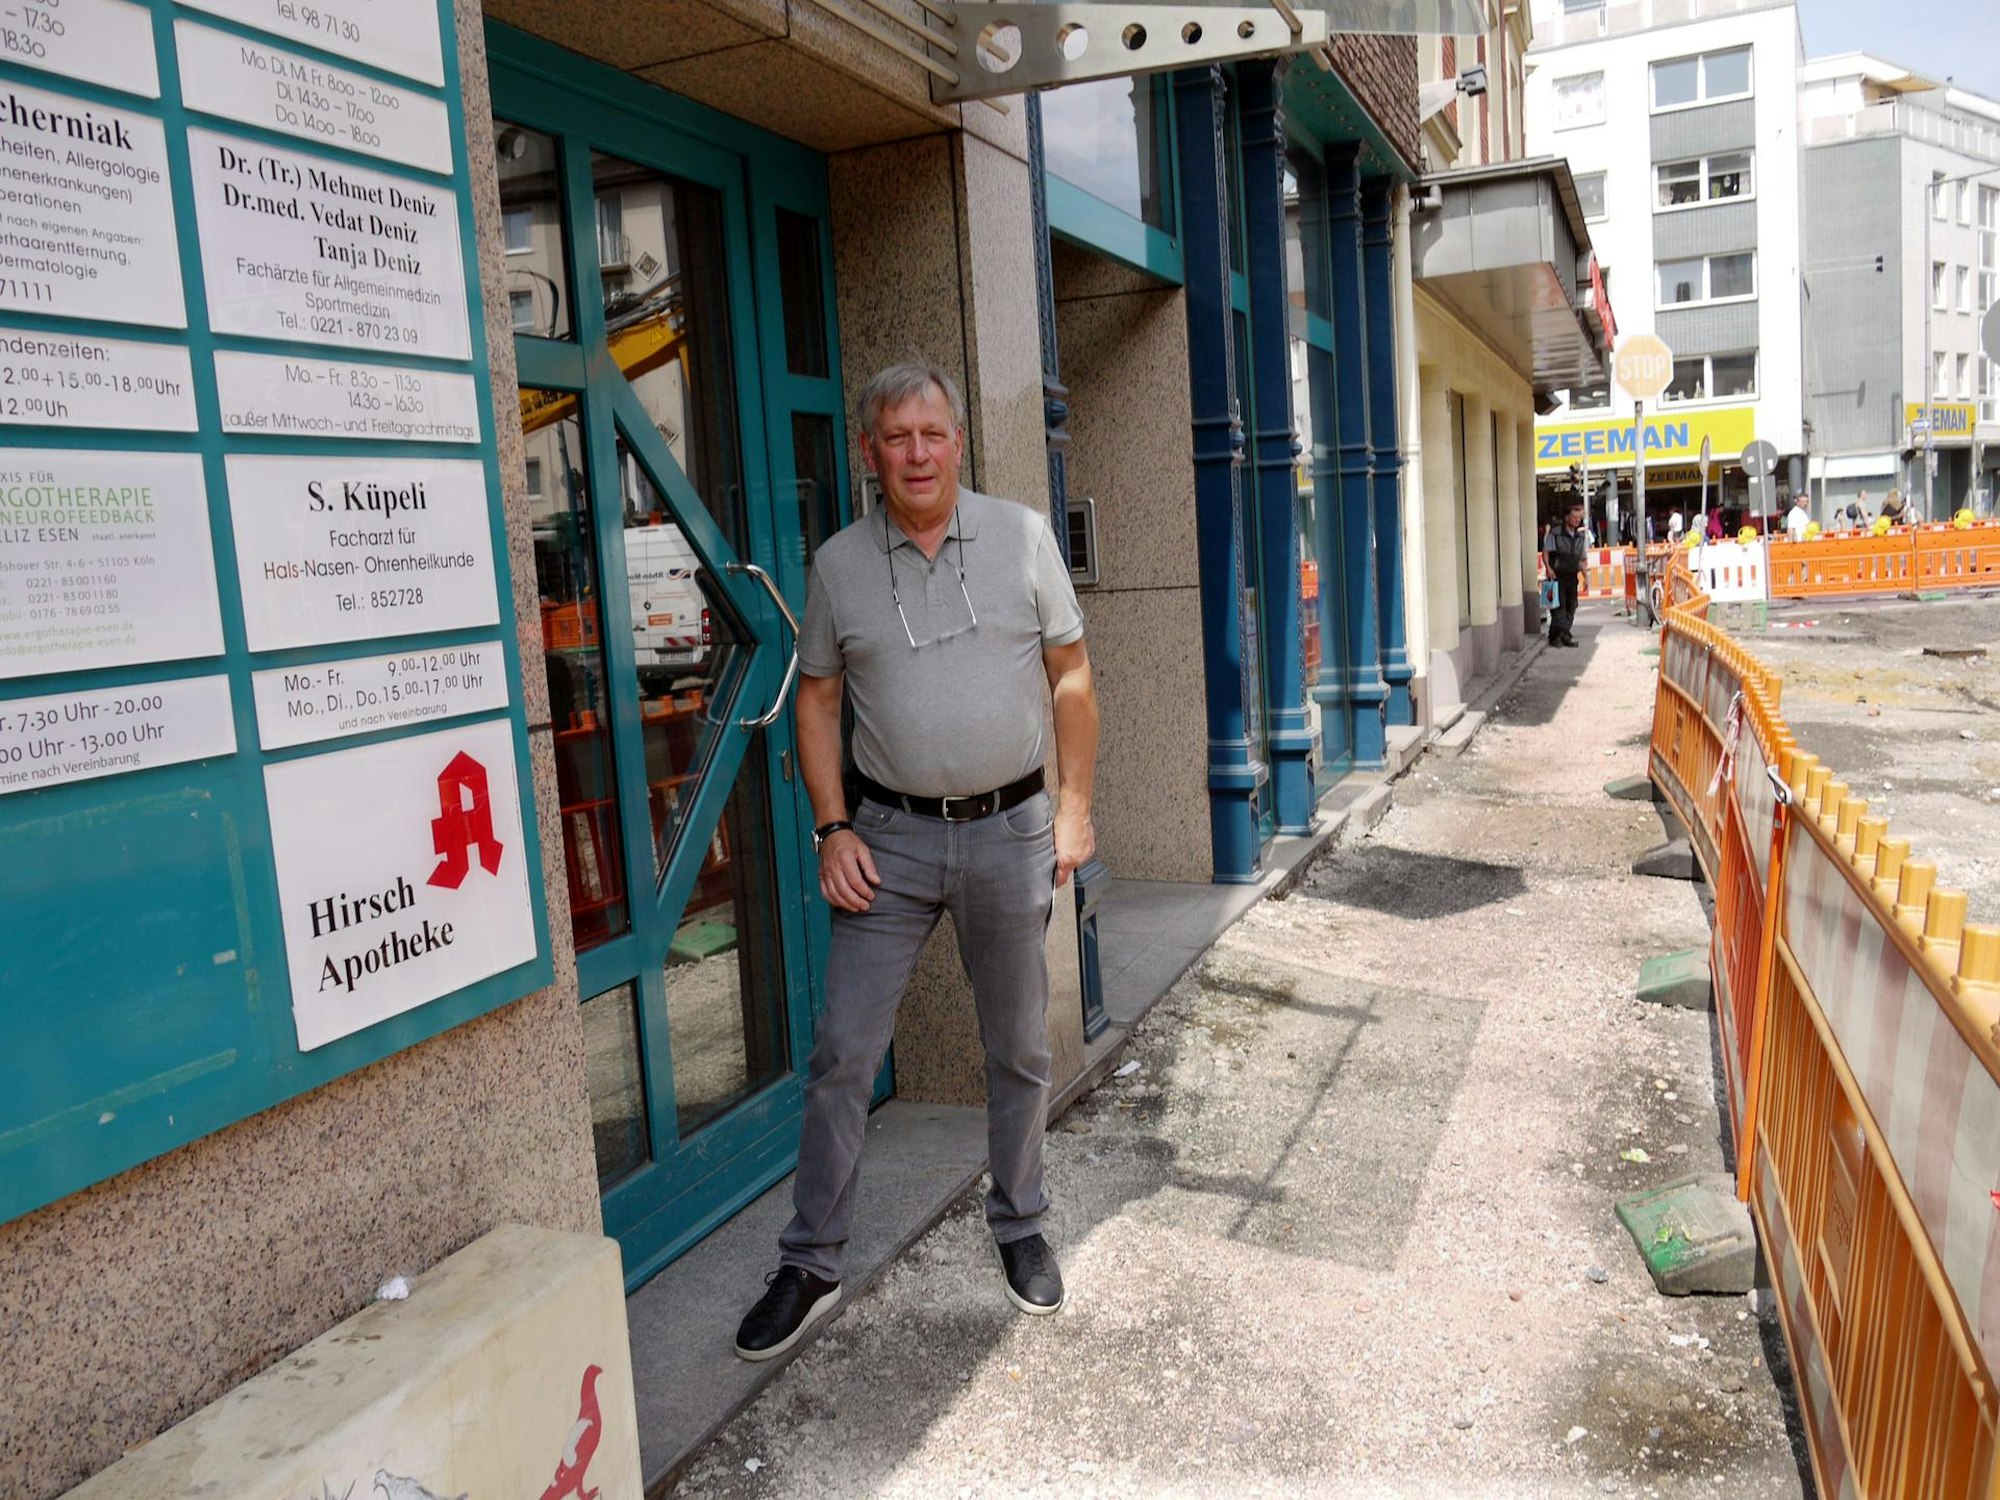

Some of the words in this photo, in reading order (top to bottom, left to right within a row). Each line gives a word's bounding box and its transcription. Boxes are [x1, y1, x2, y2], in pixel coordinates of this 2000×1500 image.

[23, 6, 65, 36] 17.30
[301, 6, 320, 29] 98
[324, 13, 338, 35] 71
[342, 20, 360, 42] 30
[0, 28, 46, 58] 18.30
[241, 48, 268, 70] Mo.
[311, 69, 324, 88] Fr.
[276, 81, 293, 101] Di.
[297, 87, 330, 112] 14.30
[275, 104, 299, 126] Do.
[302, 111, 335, 135] 14.00
[351, 124, 381, 147] 18.00
[66, 150, 160, 184] Allergologie
[218, 147, 252, 176] Dr.
[258, 157, 302, 190] (Tr.)
[308, 168, 383, 205] Mehmet
[388, 189, 437, 217] Deniz
[0, 167, 133, 204] nenerkrankungen)
[223, 183, 305, 221] Dr.med.
[311, 201, 364, 233] Vedat
[369, 216, 419, 245] Deniz
[7, 215, 38, 229] nach
[41, 220, 88, 238] eigenen
[92, 228, 144, 246] Angaben:
[313, 236, 368, 270] Tanja
[373, 248, 422, 276] Deniz
[236, 257, 309, 285] Fachärzte
[312, 269, 331, 288] für
[334, 274, 441, 305] Allgemeinmedizin
[305, 292, 391, 319] Sportmedizin
[276, 311, 306, 330] Tel.:
[310, 316, 343, 335] 0221
[356, 322, 380, 340] 870
[384, 325, 400, 342] 23
[403, 328, 418, 343] 09
[0, 337, 110, 361] ndenzeiten:
[285, 364, 313, 384] Mo.
[329, 369, 343, 387] Fr.
[350, 371, 378, 389] 8.30
[395, 374, 421, 392] 11.30
[1617, 353, 1667, 381] STOP
[349, 391, 380, 410] 14.30
[395, 393, 424, 412] 16.30
[372, 418, 475, 440] Freitagnachmittags
[1916, 408, 1967, 431] ZEMAN
[1537, 423, 1689, 459] ZEEMAN
[0, 472, 22, 483] XIS
[29, 470, 54, 483] FÜR
[307, 481, 334, 512] S.
[342, 482, 428, 519] Küpeli
[0, 508, 155, 525] NEUROFEEDBACK
[0, 528, 31, 543] LIZ
[38, 527, 79, 542] ESEN
[330, 530, 394, 548] Facharzt
[398, 527, 416, 545] für
[98, 556, 130, 568] 51105
[134, 553, 156, 567] Köln
[364, 552, 475, 574] Ohrenheilkunde
[26, 576, 52, 588] 0221
[28, 592, 54, 604] 0221
[336, 594, 365, 612] Tel.:
[370, 588, 424, 608] 852728
[0, 607, 26, 622] obil:
[30, 606, 57, 620] 0176
[327, 669, 344, 686] Fr.
[459, 651, 481, 668] Uhr
[462, 673, 483, 690] Uhr
[17, 709, 58, 733] 7.30
[64, 701, 99, 722] Uhr
[114, 695, 163, 716] 20.00
[338, 717, 358, 730] und
[361, 712, 386, 728] nach
[387, 702, 448, 721] Vereinbarung
[28, 737, 65, 759] Uhr
[80, 731, 127, 755] 13.00
[132, 722, 165, 743] Uhr
[31, 763, 61, 780] nach
[63, 752, 141, 774] Vereinbarung
[308, 876, 416, 939] Hirsch
[318, 920, 455, 993] Apotheke
